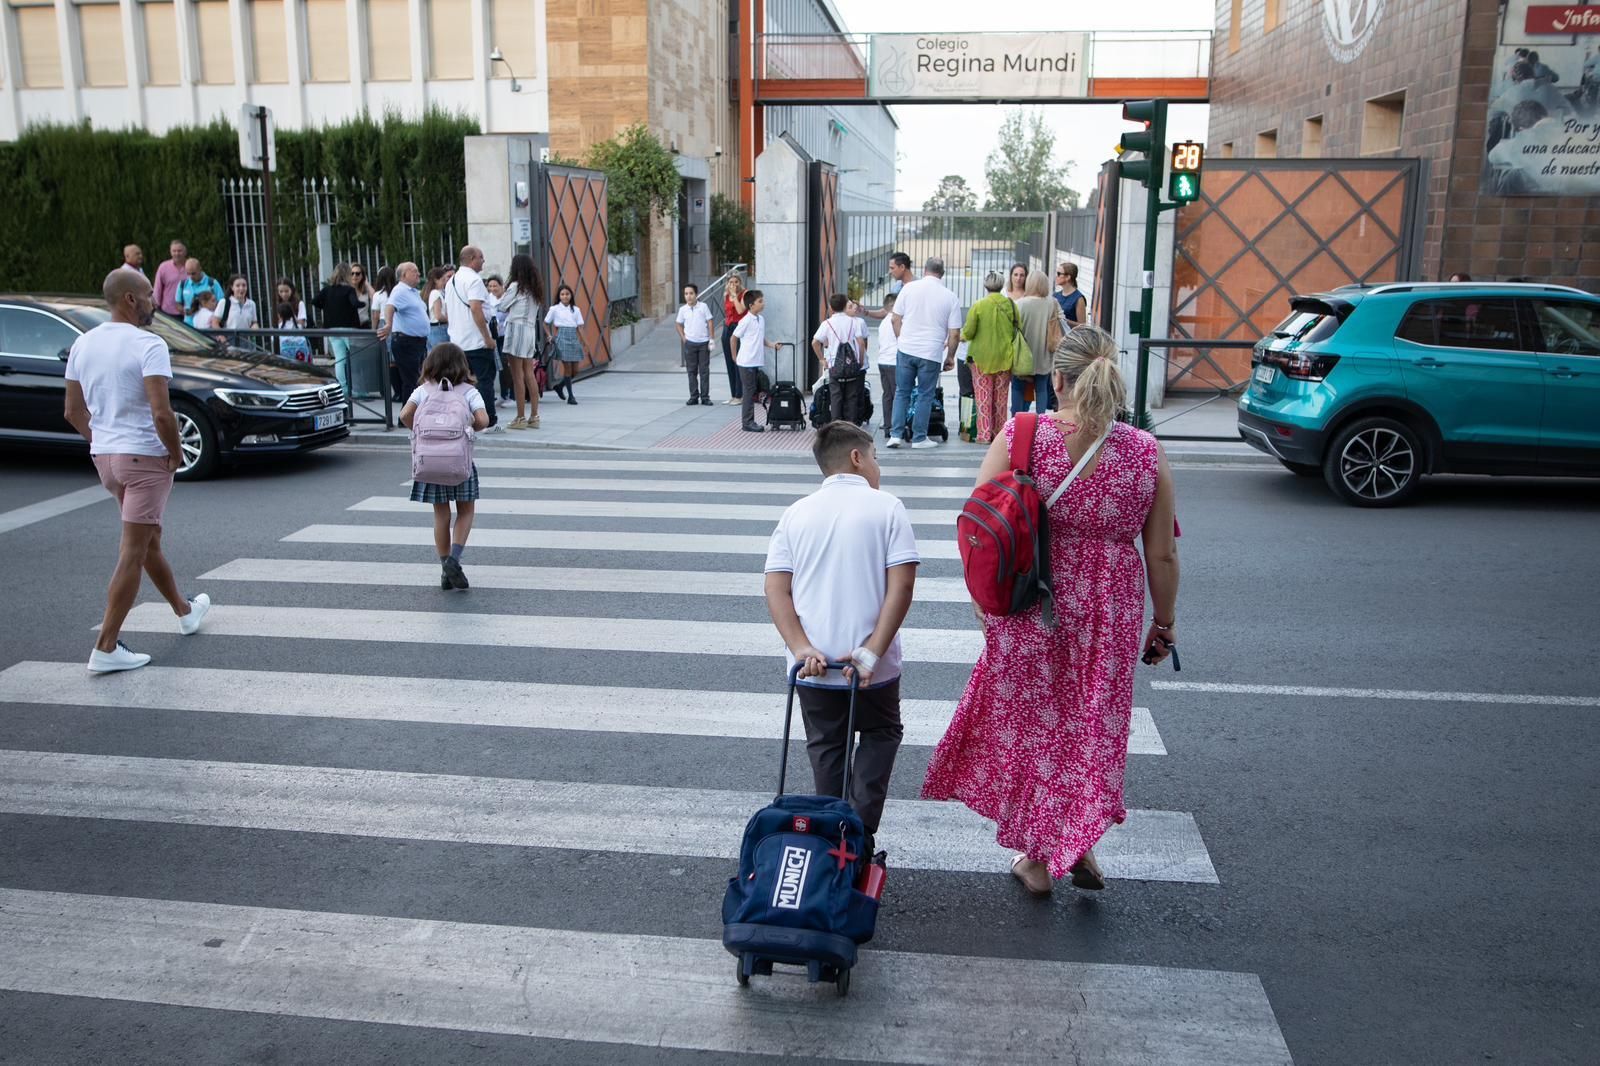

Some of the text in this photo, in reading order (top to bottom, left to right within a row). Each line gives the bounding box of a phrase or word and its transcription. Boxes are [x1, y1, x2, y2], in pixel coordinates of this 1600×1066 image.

[916, 38, 969, 52] Colegio
[917, 52, 1076, 77] Regina Mundi
[1564, 118, 1590, 134] Por
[1175, 145, 1200, 169] 28
[1522, 144, 1548, 154] una
[1541, 158, 1557, 175] de
[776, 846, 808, 909] MUNICH
